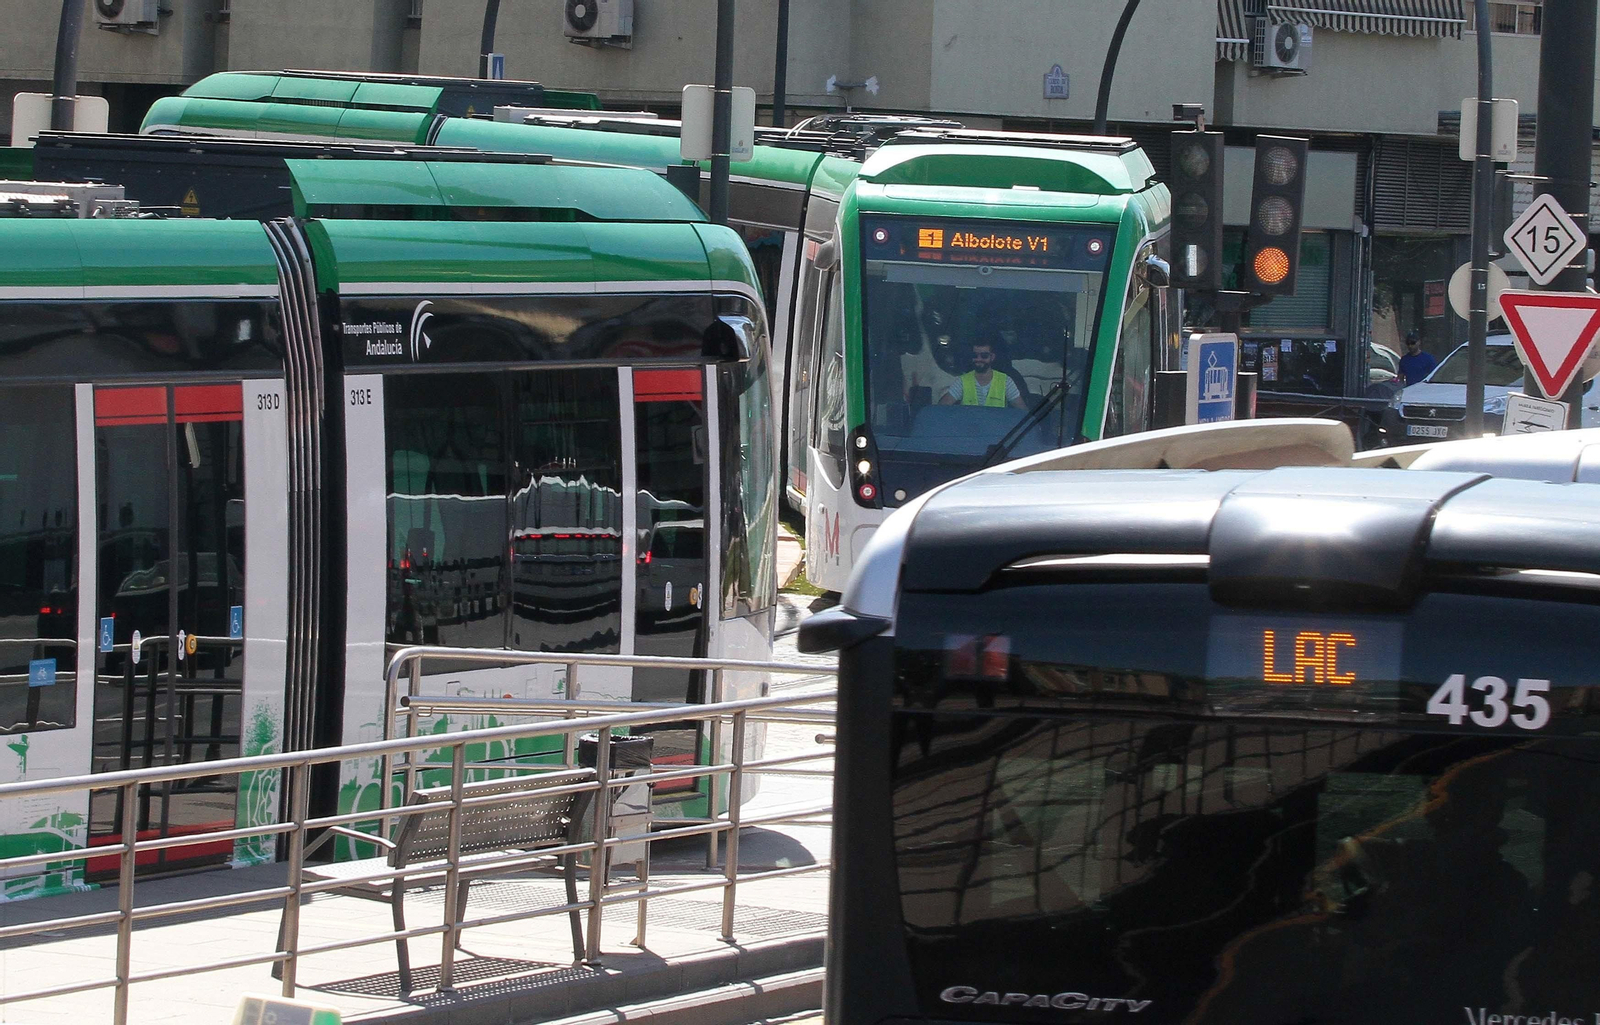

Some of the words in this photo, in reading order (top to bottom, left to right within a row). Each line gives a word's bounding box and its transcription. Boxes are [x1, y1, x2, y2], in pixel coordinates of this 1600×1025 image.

[950, 232, 1023, 250] Albolote
[1027, 236, 1048, 251] V1
[1526, 225, 1560, 254] 15
[342, 322, 372, 337] Transportes
[372, 321, 395, 334] Públicos
[395, 321, 402, 334] de
[365, 339, 403, 356] Andalucía
[257, 394, 272, 410] 313
[274, 393, 280, 410] D
[350, 389, 365, 406] 313
[366, 389, 372, 405] E
[1263, 630, 1356, 685] LAC
[1426, 674, 1550, 730] 435
